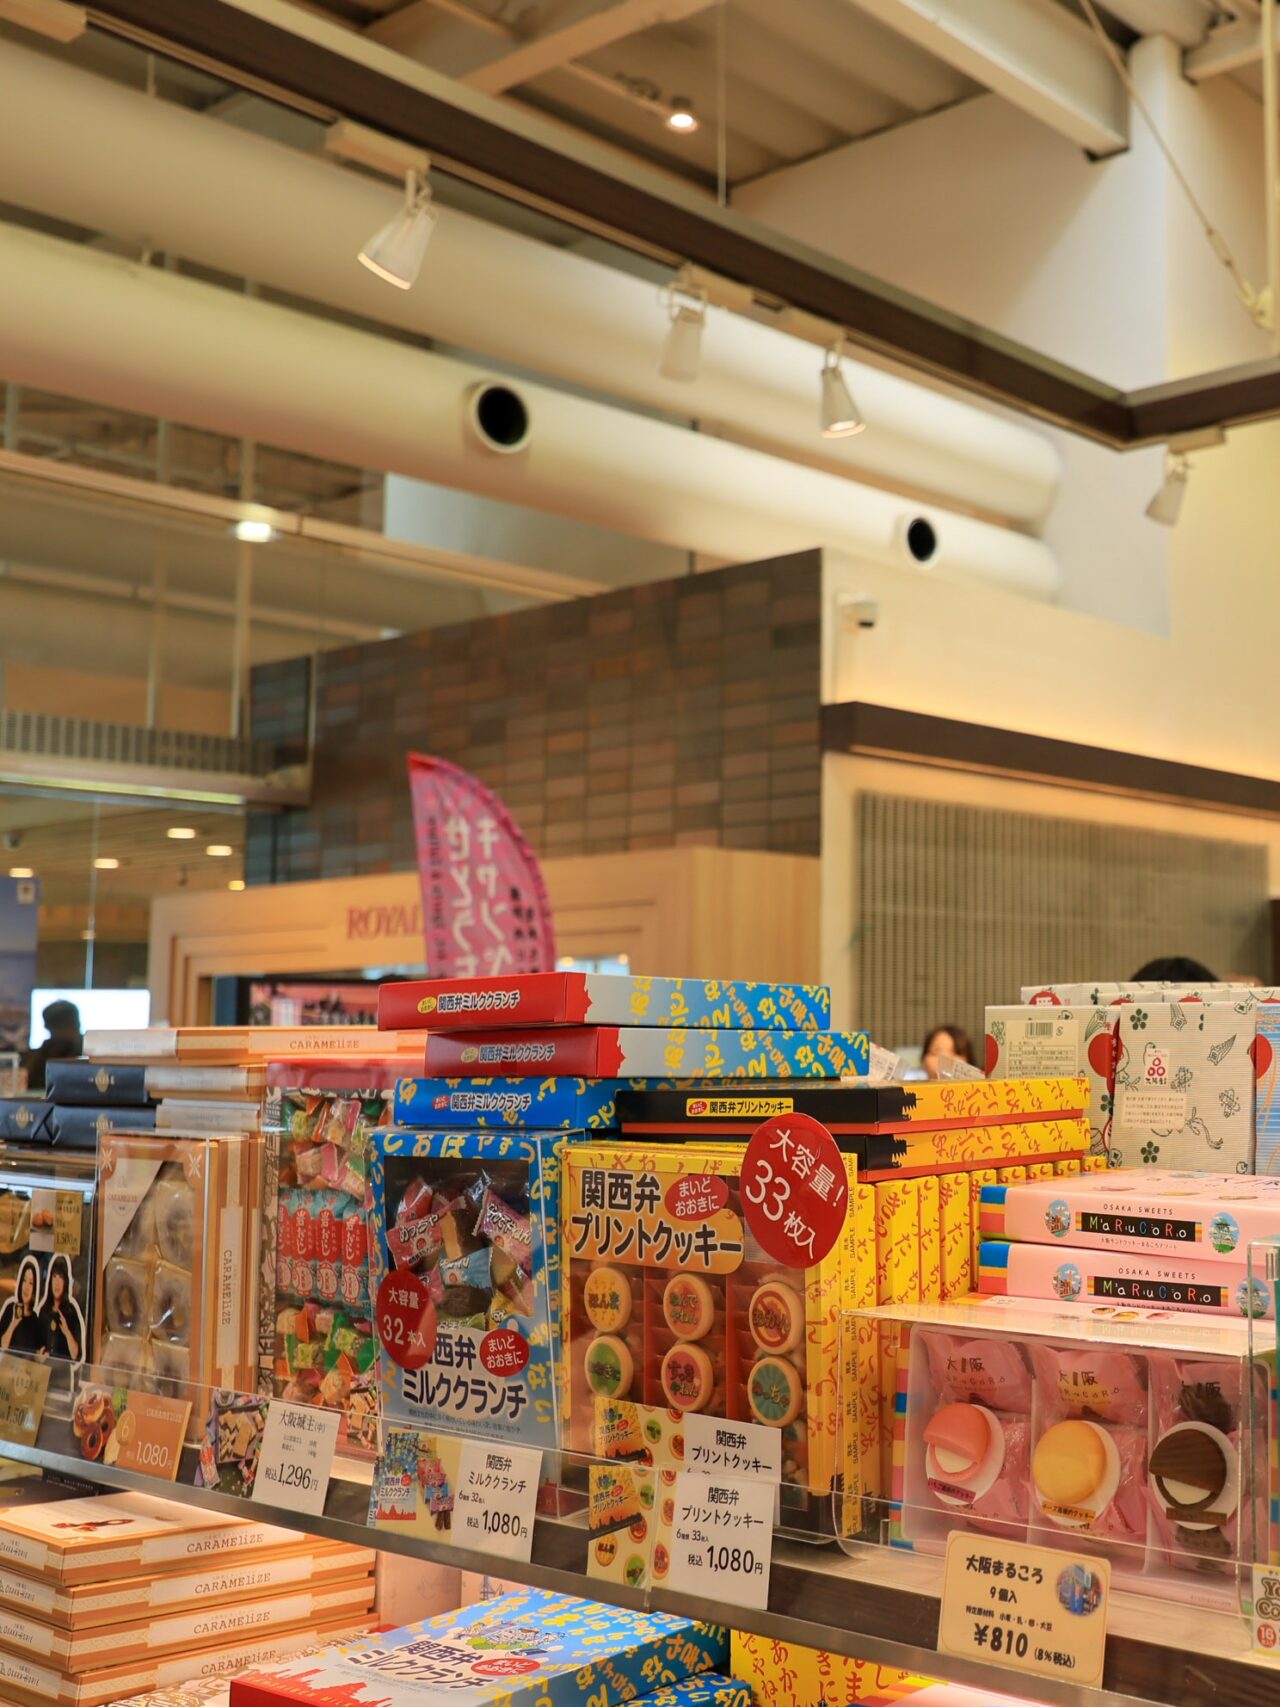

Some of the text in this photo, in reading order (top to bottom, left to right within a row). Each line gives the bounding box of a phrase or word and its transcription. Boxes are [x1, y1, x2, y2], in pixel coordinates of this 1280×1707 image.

[438, 990, 520, 1012] 関西弁ミルククランチ
[479, 1044, 556, 1063] 関西弁ミルククランチ
[451, 1093, 532, 1112] 関西弁ミルククランチ
[709, 1101, 792, 1114] 関西弁プリントクッキー
[581, 1169, 661, 1214] 関西弁
[679, 1176, 711, 1195] まいど
[675, 1195, 720, 1217] おおきに
[1104, 1204, 1173, 1216] OSAKA SWEETS
[571, 1216, 742, 1266] プリントクッキー
[1118, 1268, 1197, 1280] OSAKA SWEETS
[388, 1288, 419, 1310] 大容量
[429, 1333, 477, 1371] 西弁
[488, 1335, 516, 1351] まいど
[487, 1351, 523, 1369] おおきに
[403, 1369, 527, 1419] ミルククランチ
[716, 1430, 747, 1450] 関西弁
[486, 1454, 513, 1472] 関西弁
[692, 1447, 773, 1473] プリントクッキー
[469, 1472, 527, 1494] ミルククランチ
[708, 1487, 740, 1506] 関西弁
[482, 1510, 528, 1539] 1,080円
[682, 1506, 764, 1528] プリントクッキー
[707, 1545, 763, 1575] 1,080円
[966, 1554, 1044, 1584] 大阪まるころ
[974, 1623, 1029, 1658] ¥810
[394, 1640, 484, 1668] 関西弁
[347, 1649, 494, 1689] ミルククランチ
